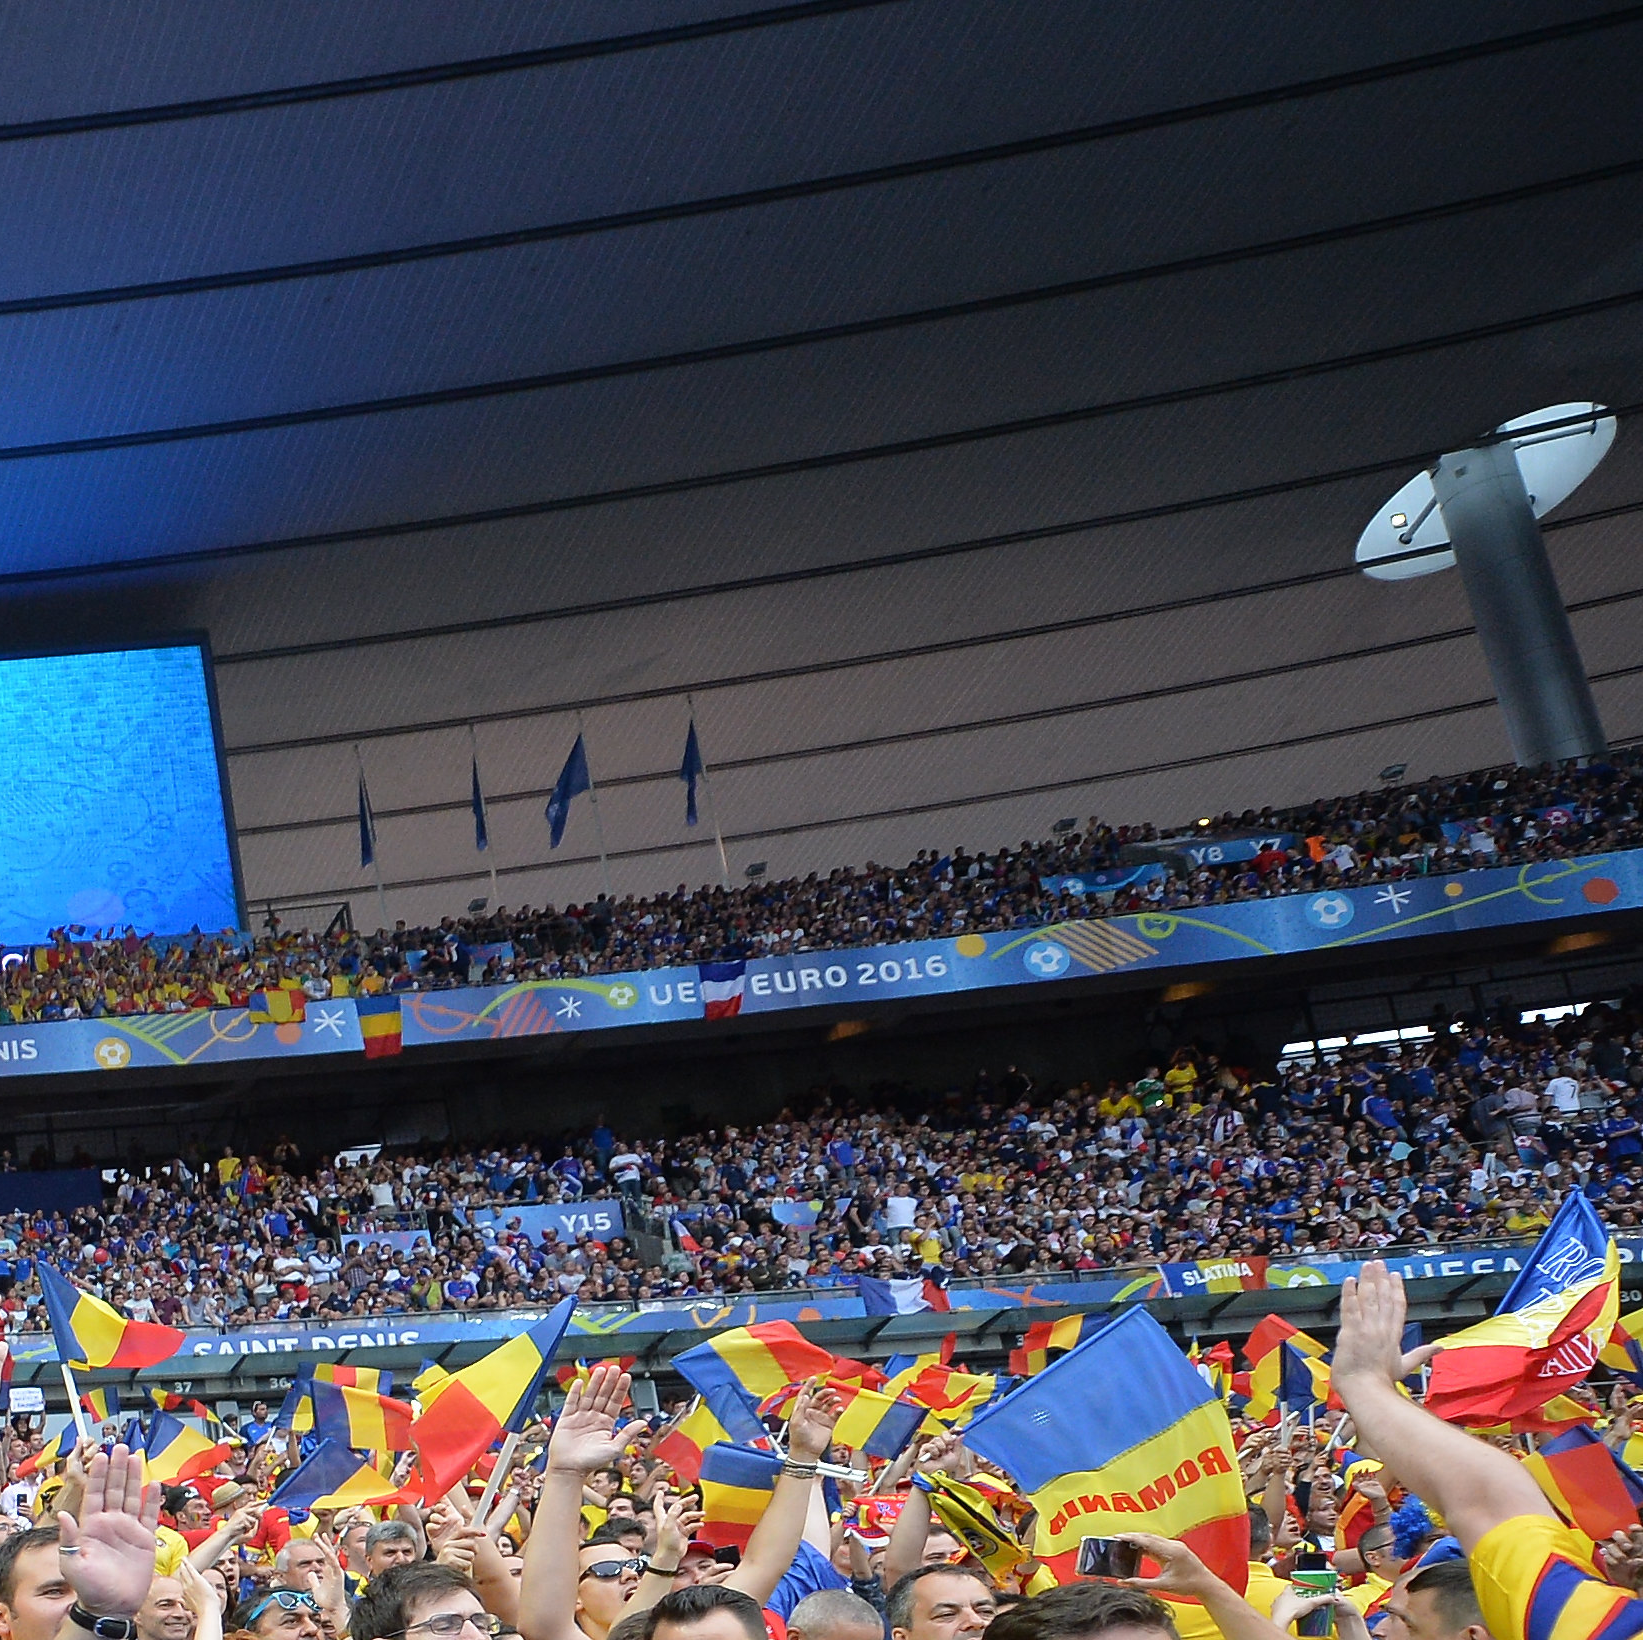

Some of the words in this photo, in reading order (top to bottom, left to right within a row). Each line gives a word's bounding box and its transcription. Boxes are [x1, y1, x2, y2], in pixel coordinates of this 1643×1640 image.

[1190, 846, 1224, 865] Y8
[751, 966, 848, 996] EURO
[856, 954, 949, 985] 2016
[559, 1212, 612, 1233] Y15
[1182, 1261, 1255, 1286] SLATINA
[1619, 1289, 1643, 1303] 30
[174, 1381, 193, 1393] 37
